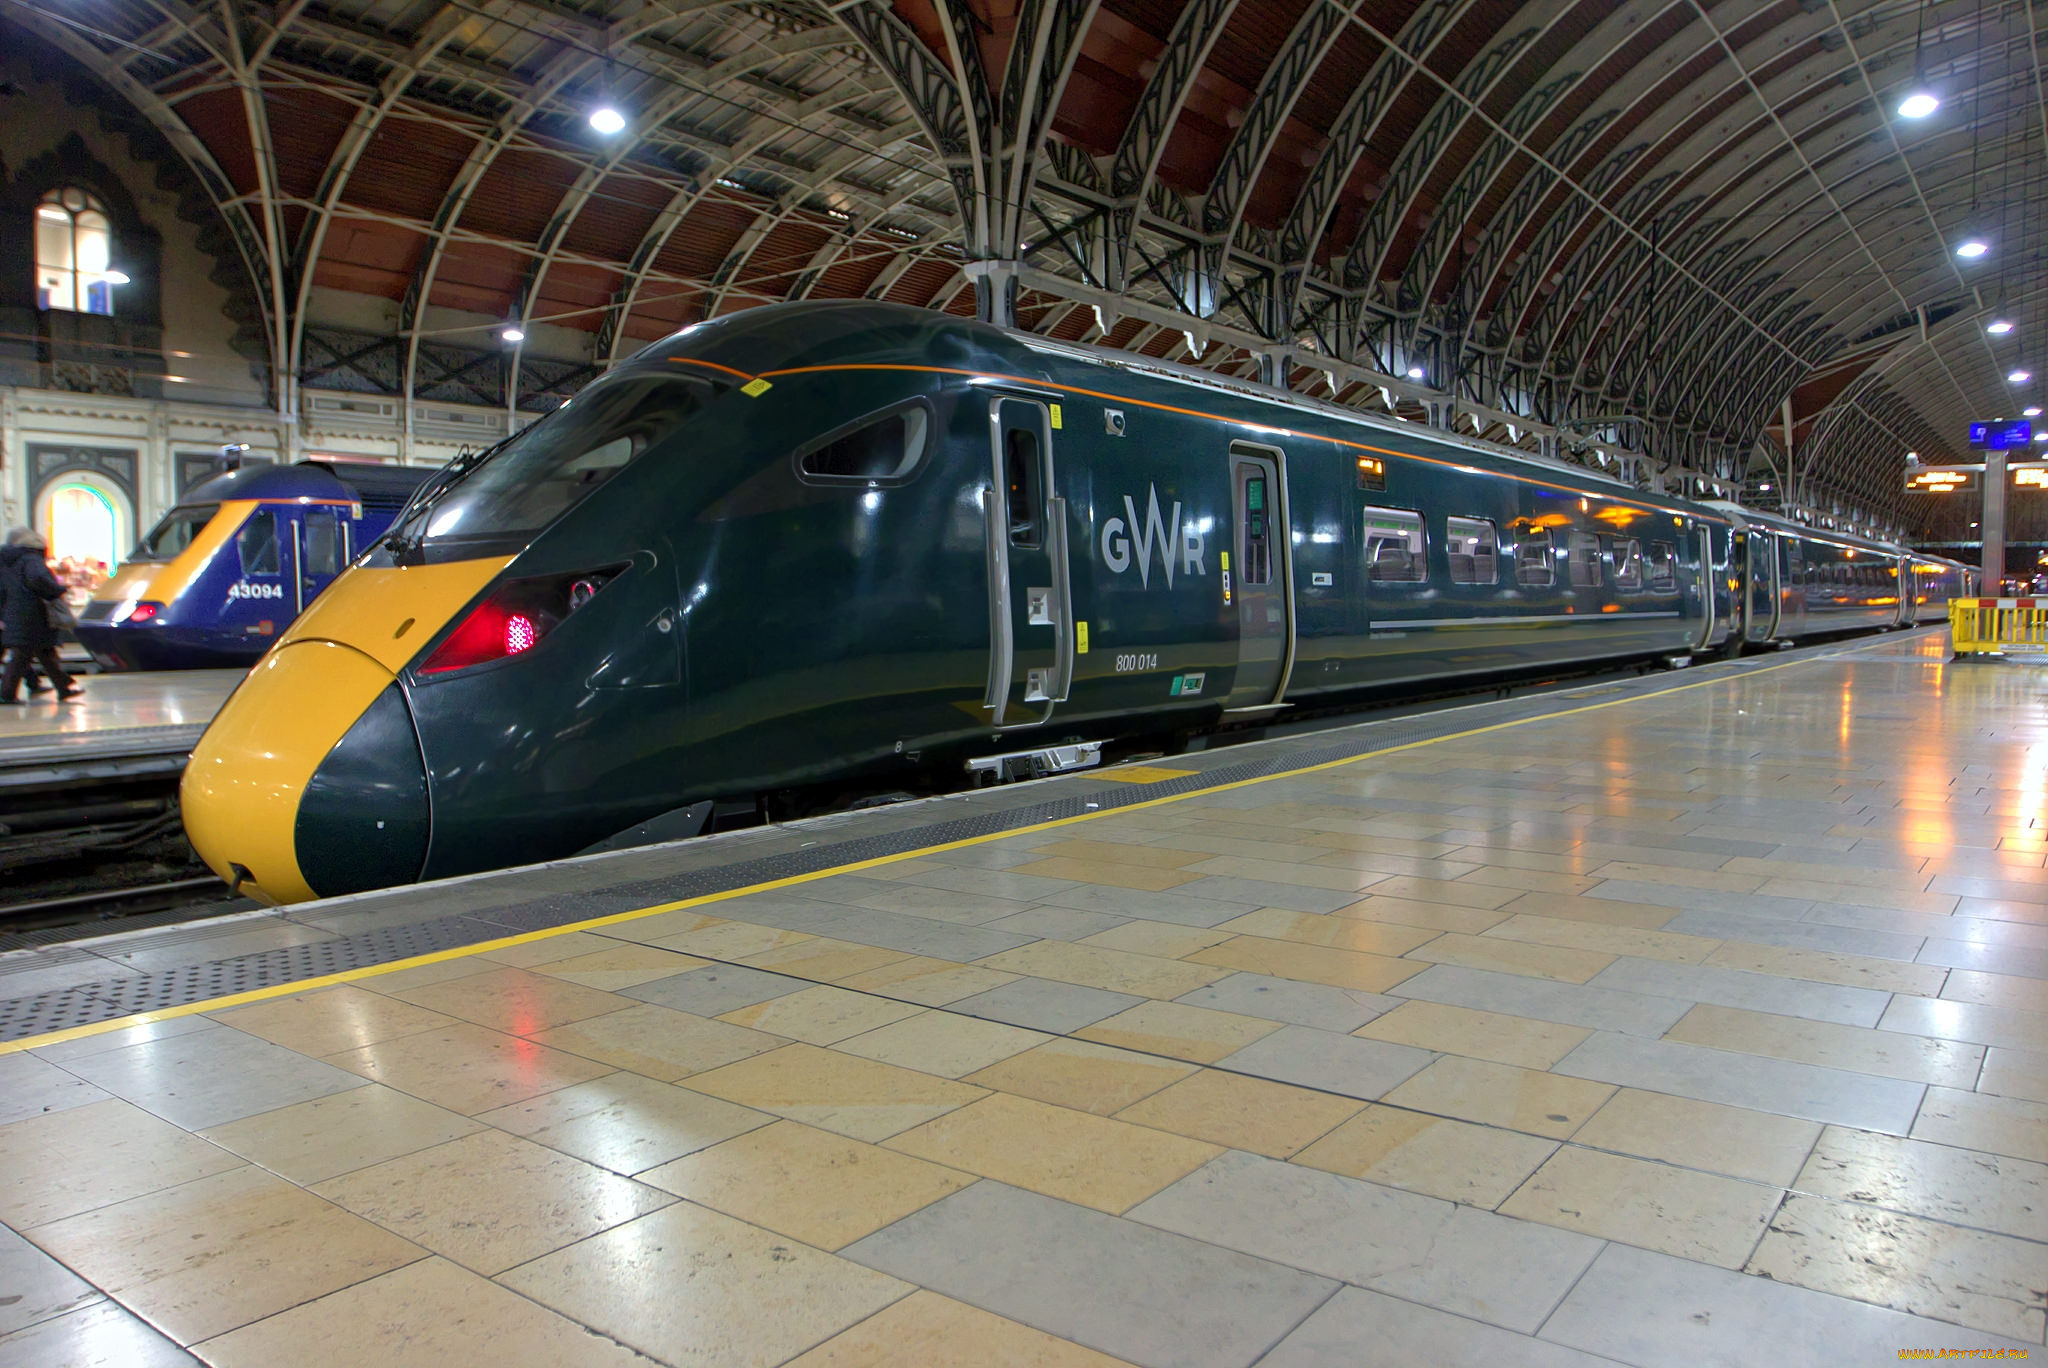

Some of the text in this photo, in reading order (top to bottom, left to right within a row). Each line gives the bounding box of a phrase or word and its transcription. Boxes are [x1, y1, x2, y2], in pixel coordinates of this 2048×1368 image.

[1101, 480, 1206, 591] GWR
[228, 583, 283, 599] 43094
[1116, 654, 1157, 672] 800 014
